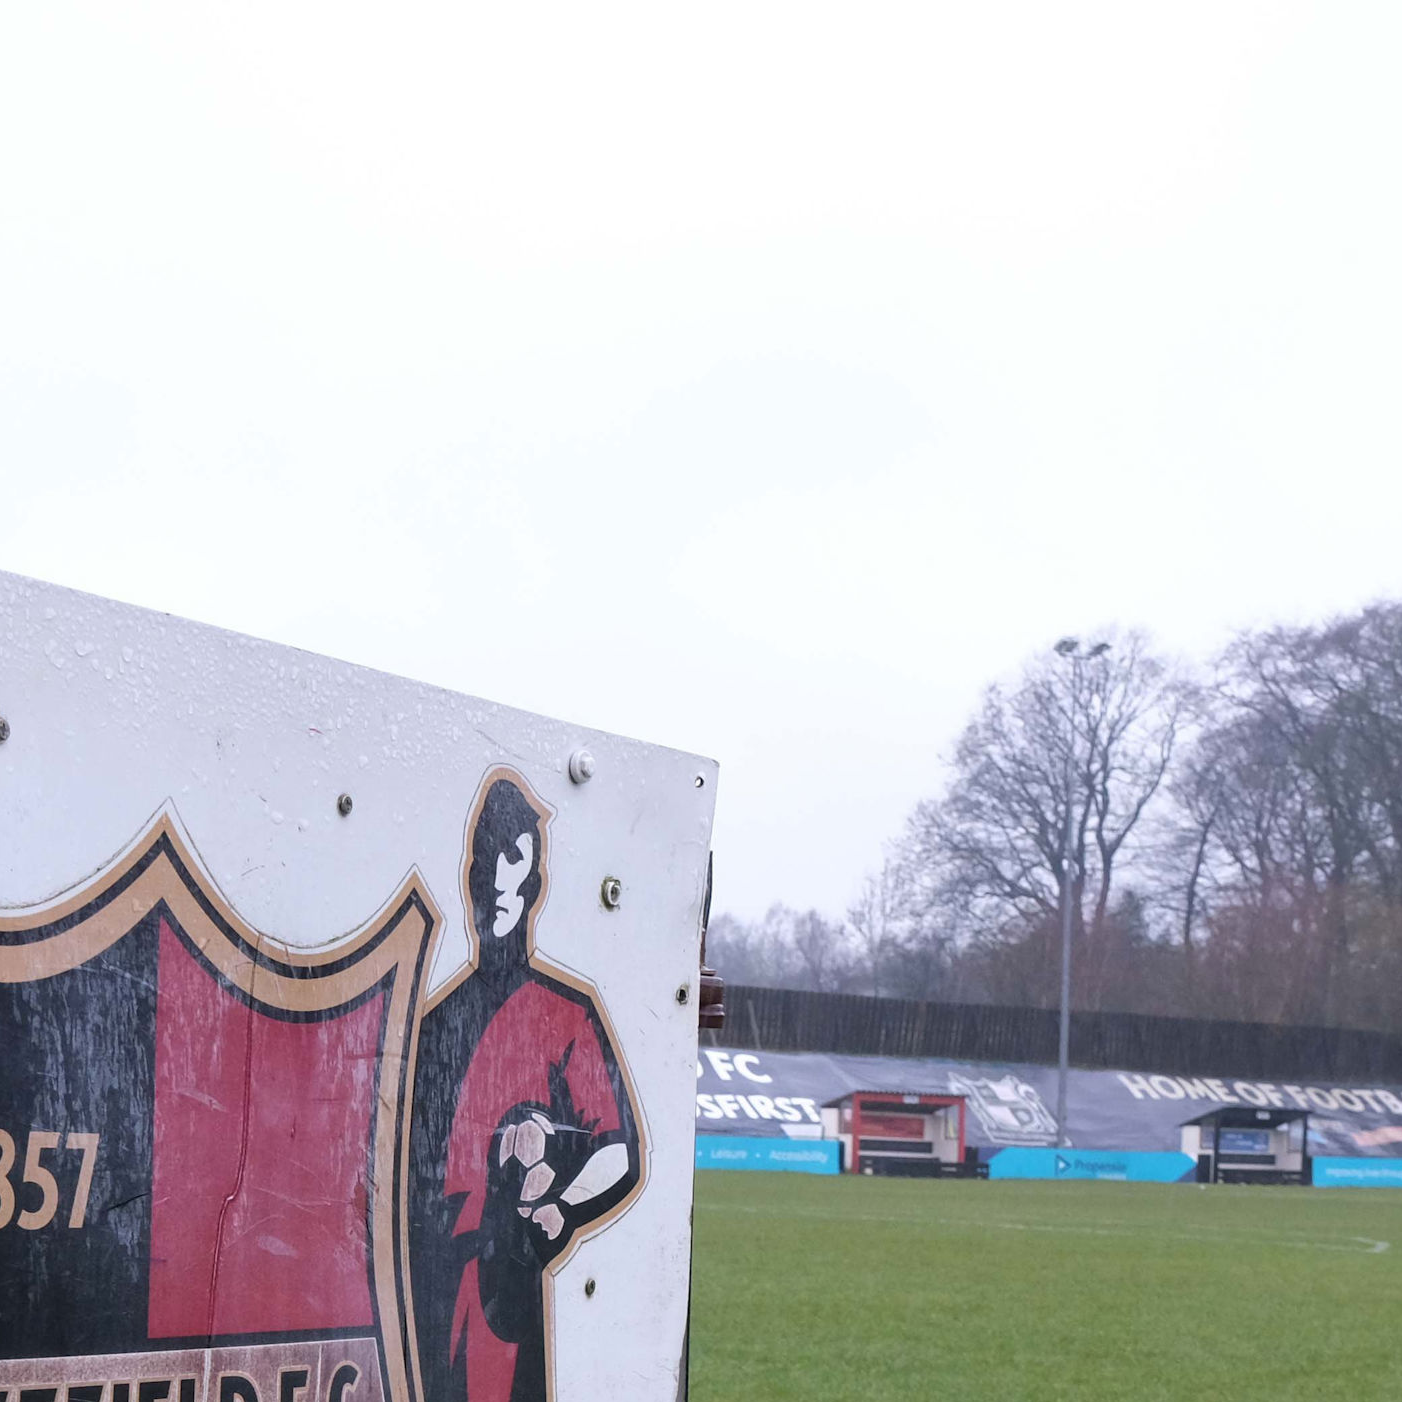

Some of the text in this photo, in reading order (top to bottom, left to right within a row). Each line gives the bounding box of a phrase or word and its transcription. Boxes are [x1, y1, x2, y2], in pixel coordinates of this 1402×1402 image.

[703, 1050, 773, 1083] FC
[1118, 1074, 1239, 1103] HOME
[1234, 1082, 1288, 1108] OF
[696, 1094, 821, 1122] SFIRST
